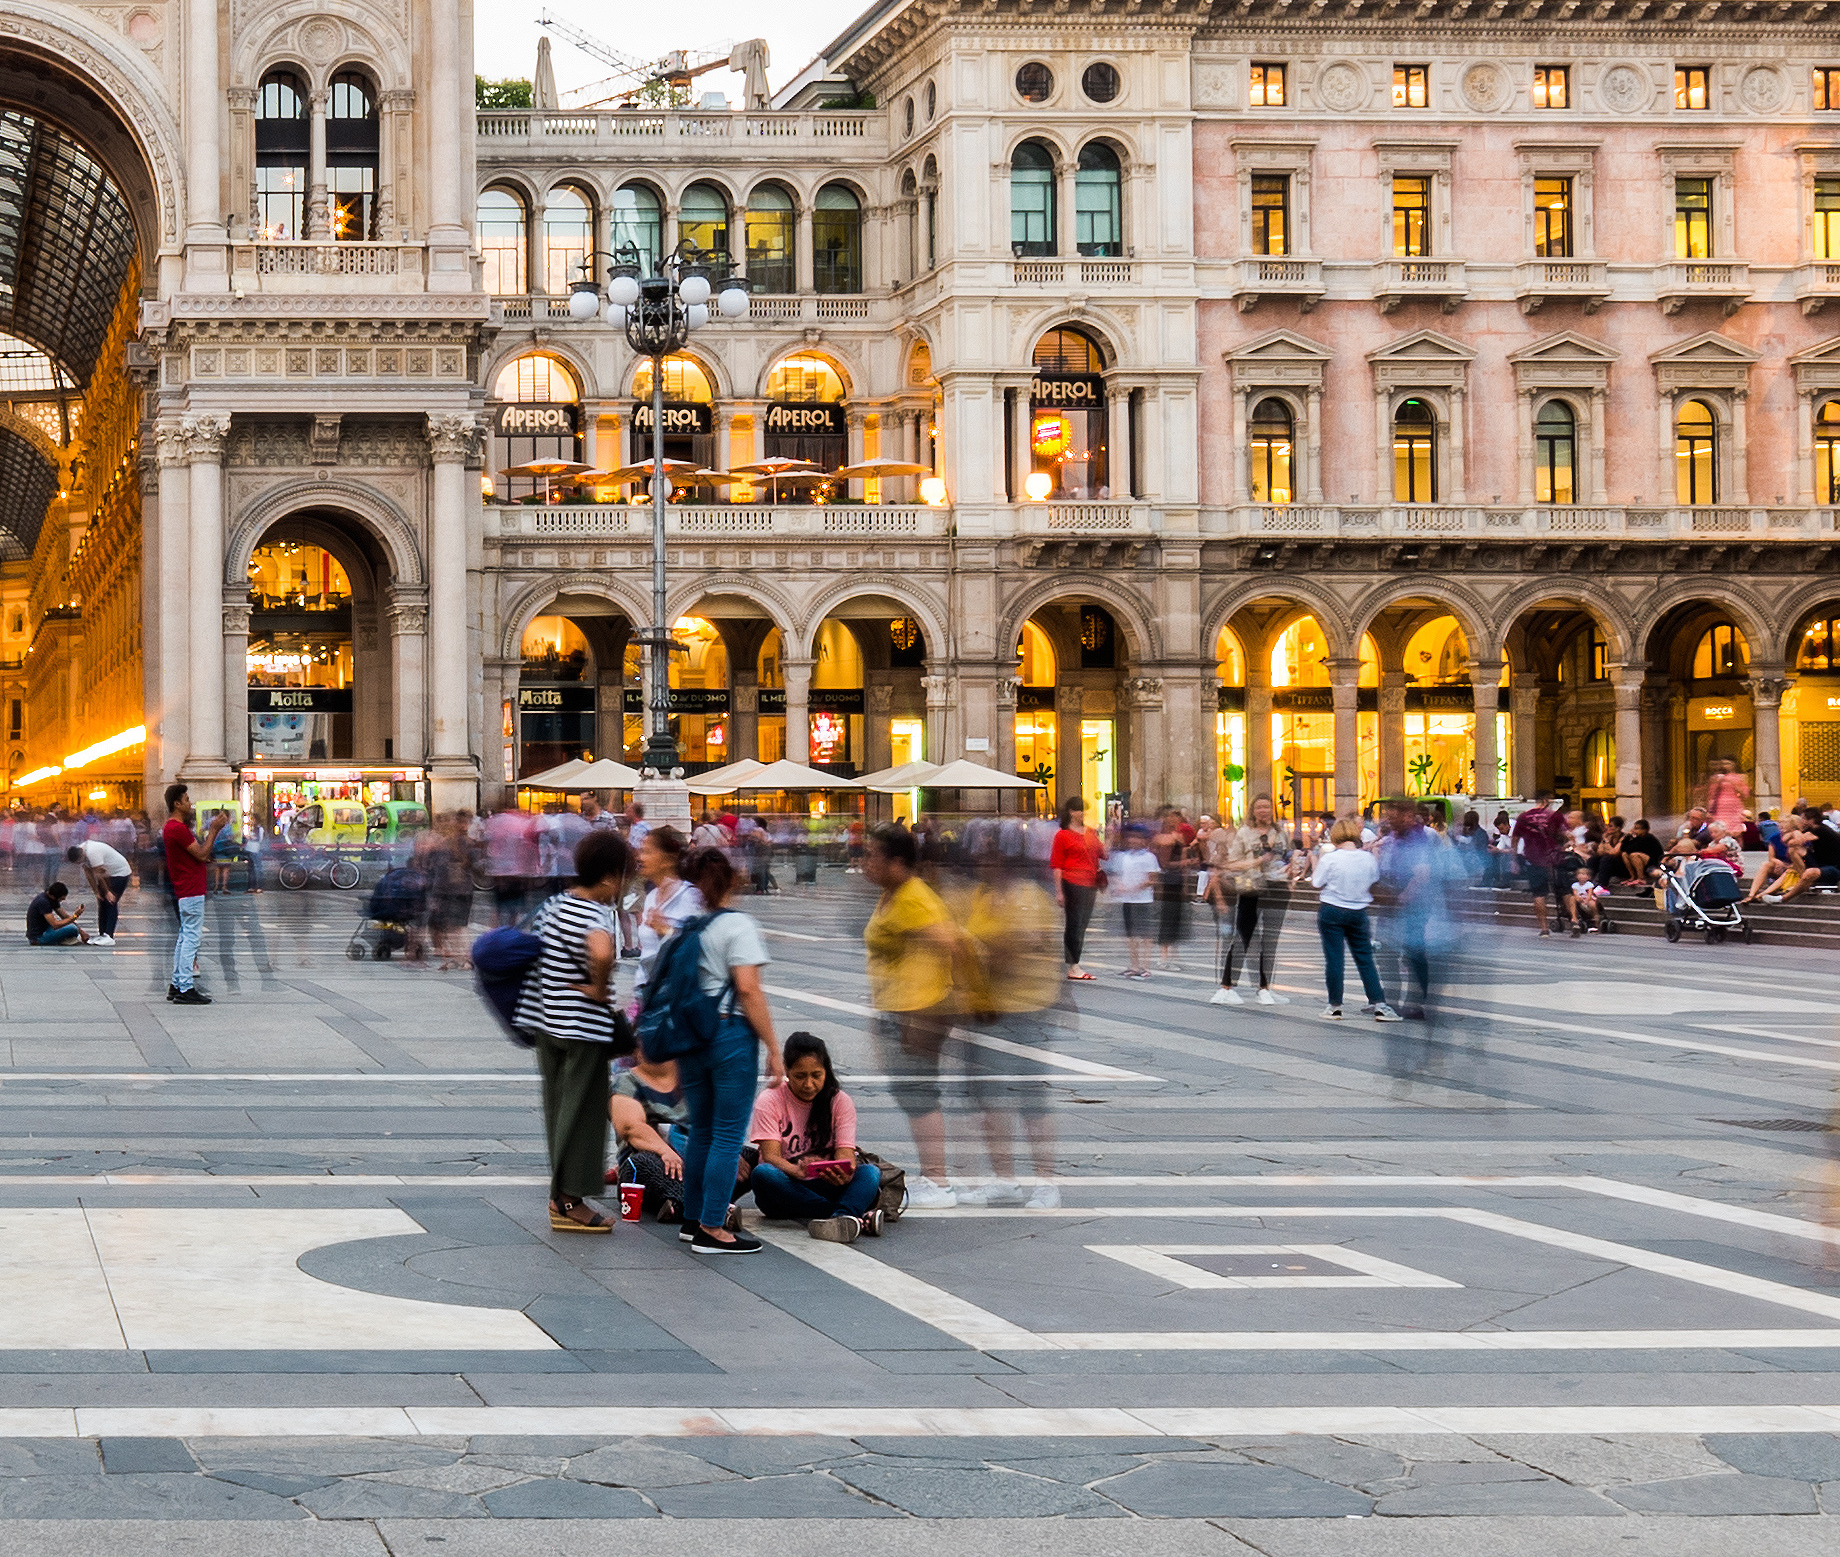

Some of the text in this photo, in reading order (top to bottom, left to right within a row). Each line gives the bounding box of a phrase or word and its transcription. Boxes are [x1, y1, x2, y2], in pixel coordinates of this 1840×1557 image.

[1031, 378, 1096, 399] APEROL
[501, 406, 569, 427] APEROL
[768, 406, 834, 427] APEROL
[269, 691, 313, 707] Motta
[520, 690, 563, 705] Motta
[690, 694, 727, 702] DUOMO
[825, 694, 860, 702] DUOMO
[1705, 707, 1734, 716] ROCCA
